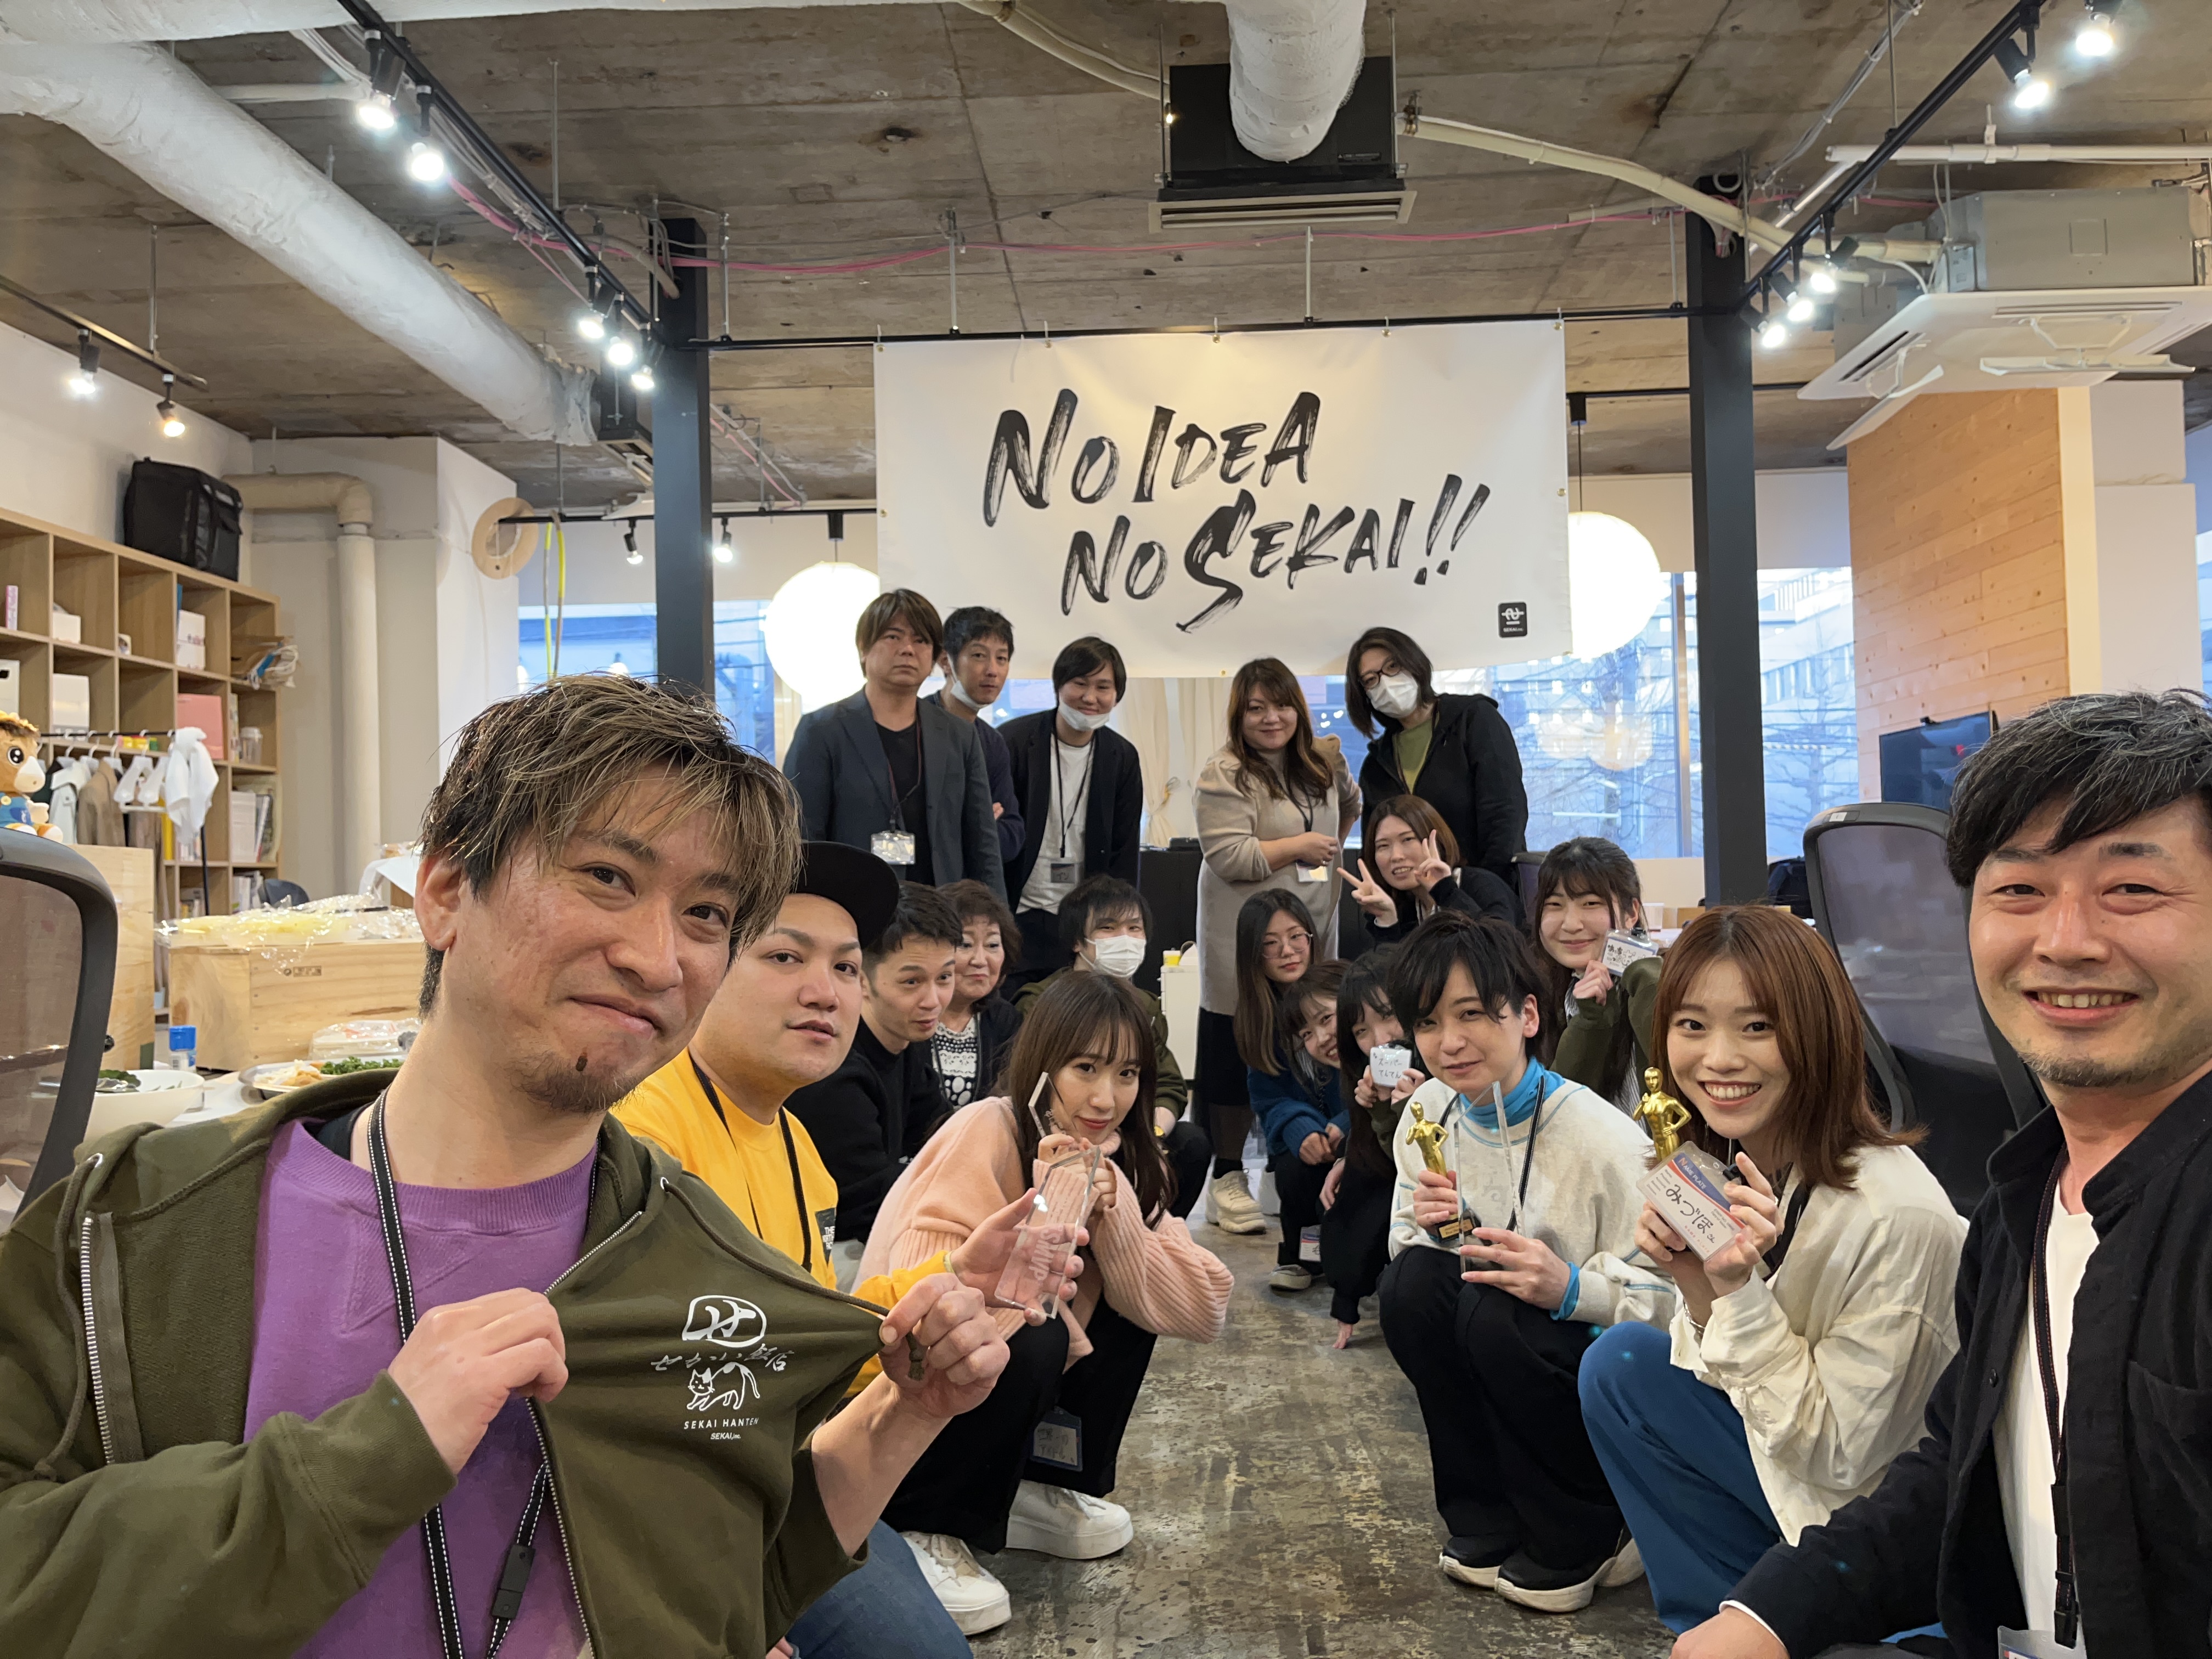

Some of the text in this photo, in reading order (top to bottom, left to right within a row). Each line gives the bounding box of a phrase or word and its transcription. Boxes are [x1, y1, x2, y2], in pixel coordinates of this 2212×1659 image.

[983, 388, 1321, 528] NO IDEA
[1060, 474, 1490, 635] NO SEKAI!!
[1378, 1058, 1402, 1066] スーパー
[1692, 1173, 1707, 1189] PLATE
[824, 1226, 836, 1234] THE
[684, 1417, 760, 1430] SEKAI HANTEN
